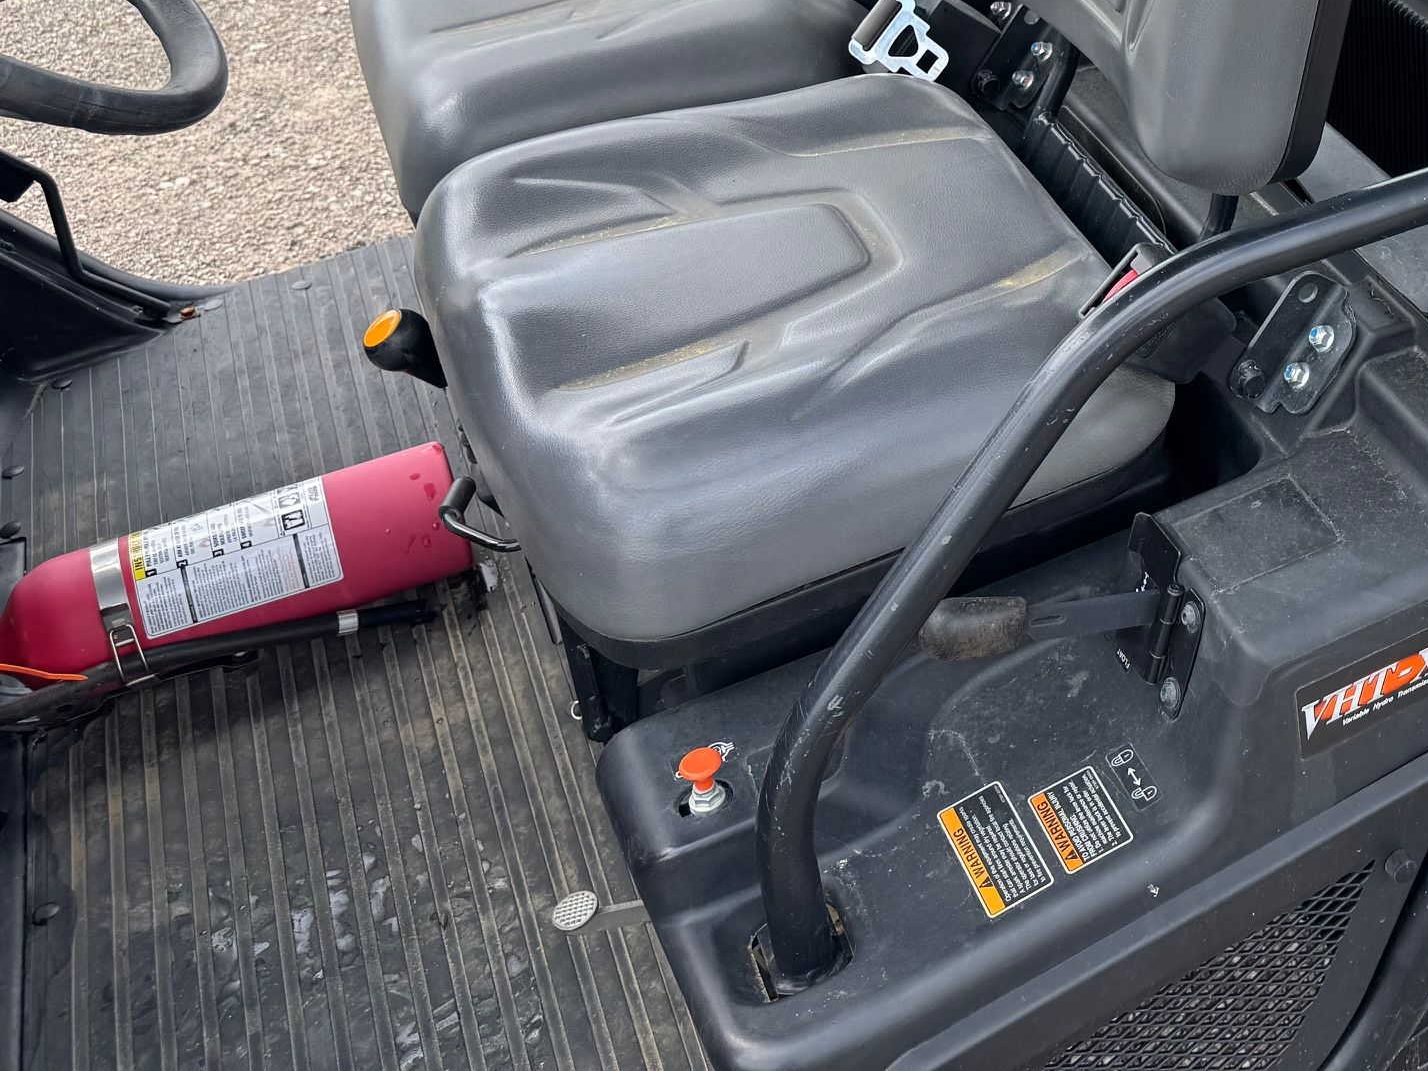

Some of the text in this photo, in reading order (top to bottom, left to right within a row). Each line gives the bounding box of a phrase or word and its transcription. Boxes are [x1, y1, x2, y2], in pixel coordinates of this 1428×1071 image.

[1343, 708, 1370, 725] Variable
[1373, 696, 1393, 711] Hydro
[1035, 800, 1072, 852] WARNING
[1046, 790, 1090, 861] TO AVOID PERSONAL INJURY
[1068, 812, 1097, 857] FROM CRUSHING.
[952, 827, 986, 878] WARNING
